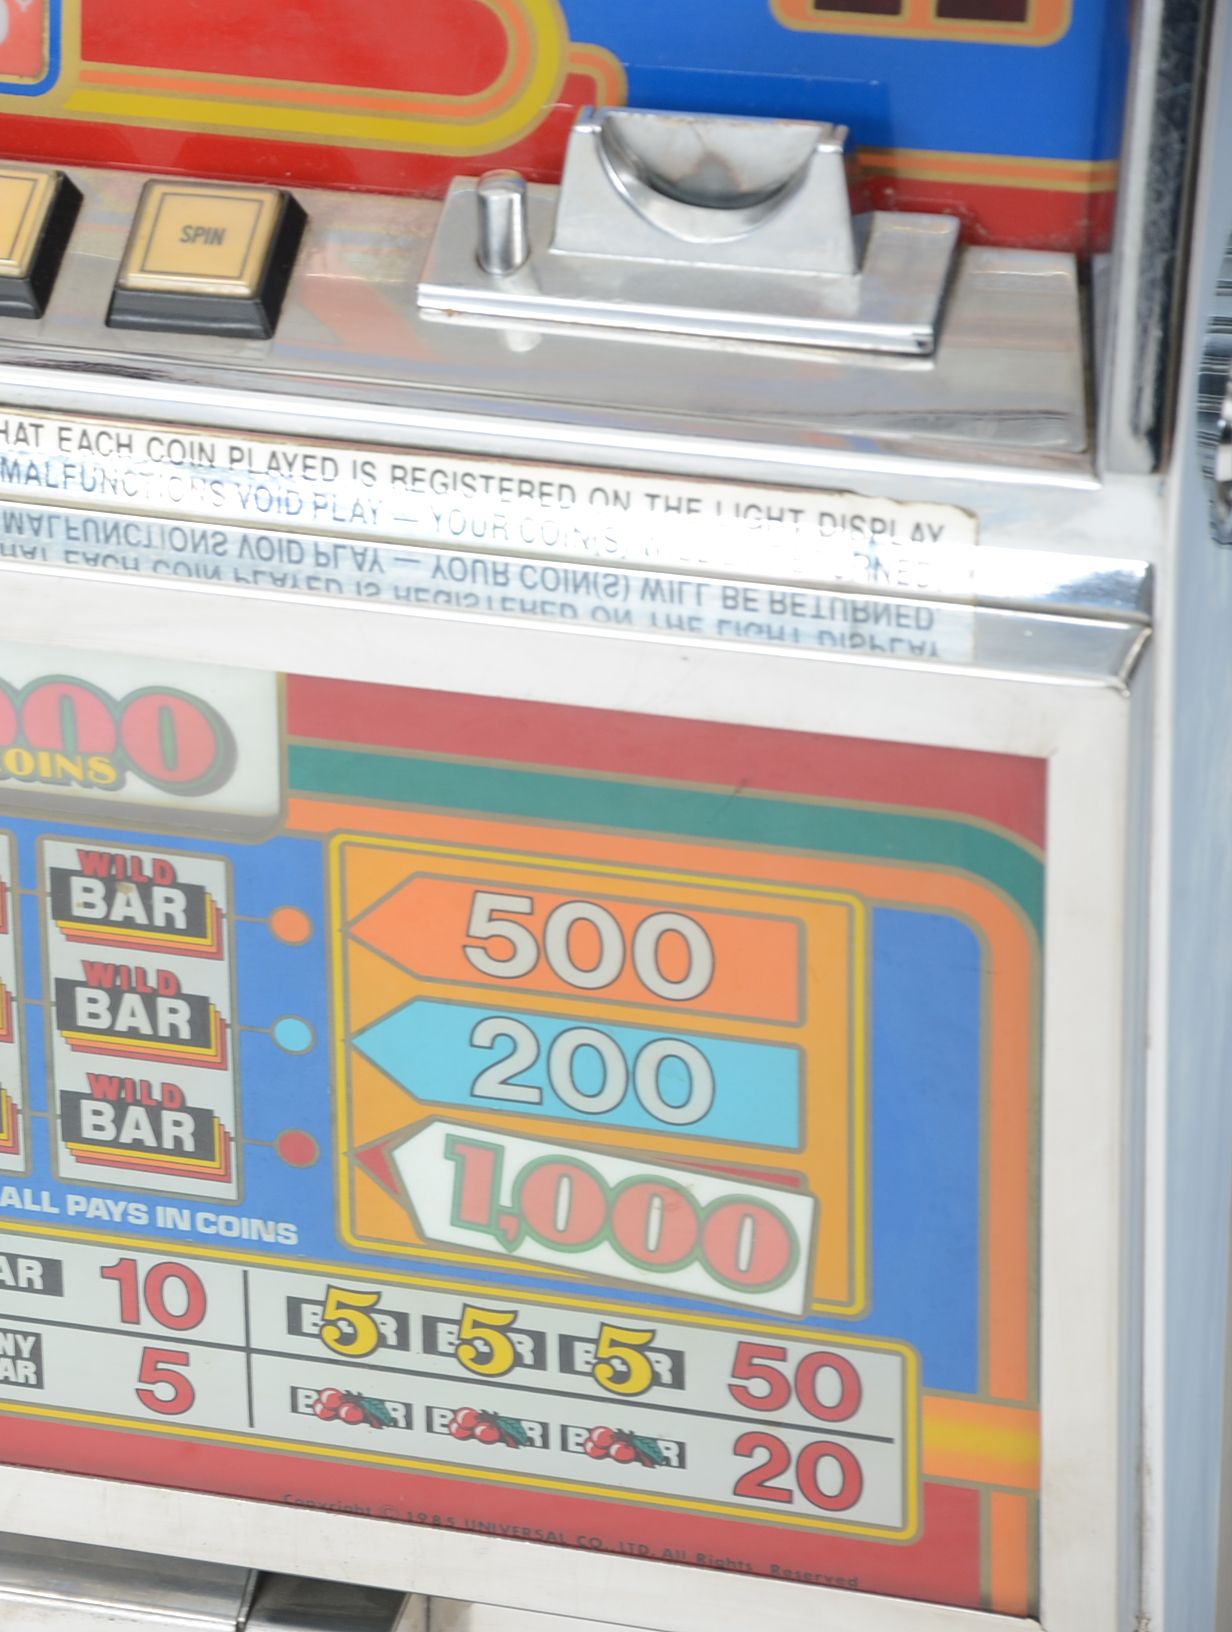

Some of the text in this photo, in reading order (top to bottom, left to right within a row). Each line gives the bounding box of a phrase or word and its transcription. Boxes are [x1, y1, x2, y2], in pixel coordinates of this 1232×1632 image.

[180, 222, 226, 248] SPIN
[58, 425, 133, 457] EACH
[146, 436, 215, 468] COIN
[228, 445, 338, 482] PLAYED
[352, 459, 377, 487] IS
[390, 463, 576, 509] REGISTERED
[589, 486, 631, 511] ON
[644, 492, 702, 514] THE
[76, 849, 176, 885] WILD
[71, 877, 187, 929] BAR
[462, 889, 716, 1001] 500
[81, 960, 181, 995] WILD
[76, 987, 192, 1040] BAR
[86, 1072, 185, 1109] WILD
[469, 1015, 716, 1126] 200
[80, 1100, 197, 1152] BAR
[63, 1193, 149, 1225] PAYS
[155, 1203, 190, 1228] IN
[195, 1211, 299, 1245] COINS
[443, 1133, 799, 1294] 1,000
[99, 1257, 208, 1331] 10
[135, 1347, 196, 1415] 5
[319, 1283, 382, 1359] 5
[455, 1303, 518, 1378] 5
[592, 1322, 657, 1397] 5
[728, 1341, 863, 1422] 50
[732, 1431, 864, 1511] 20
